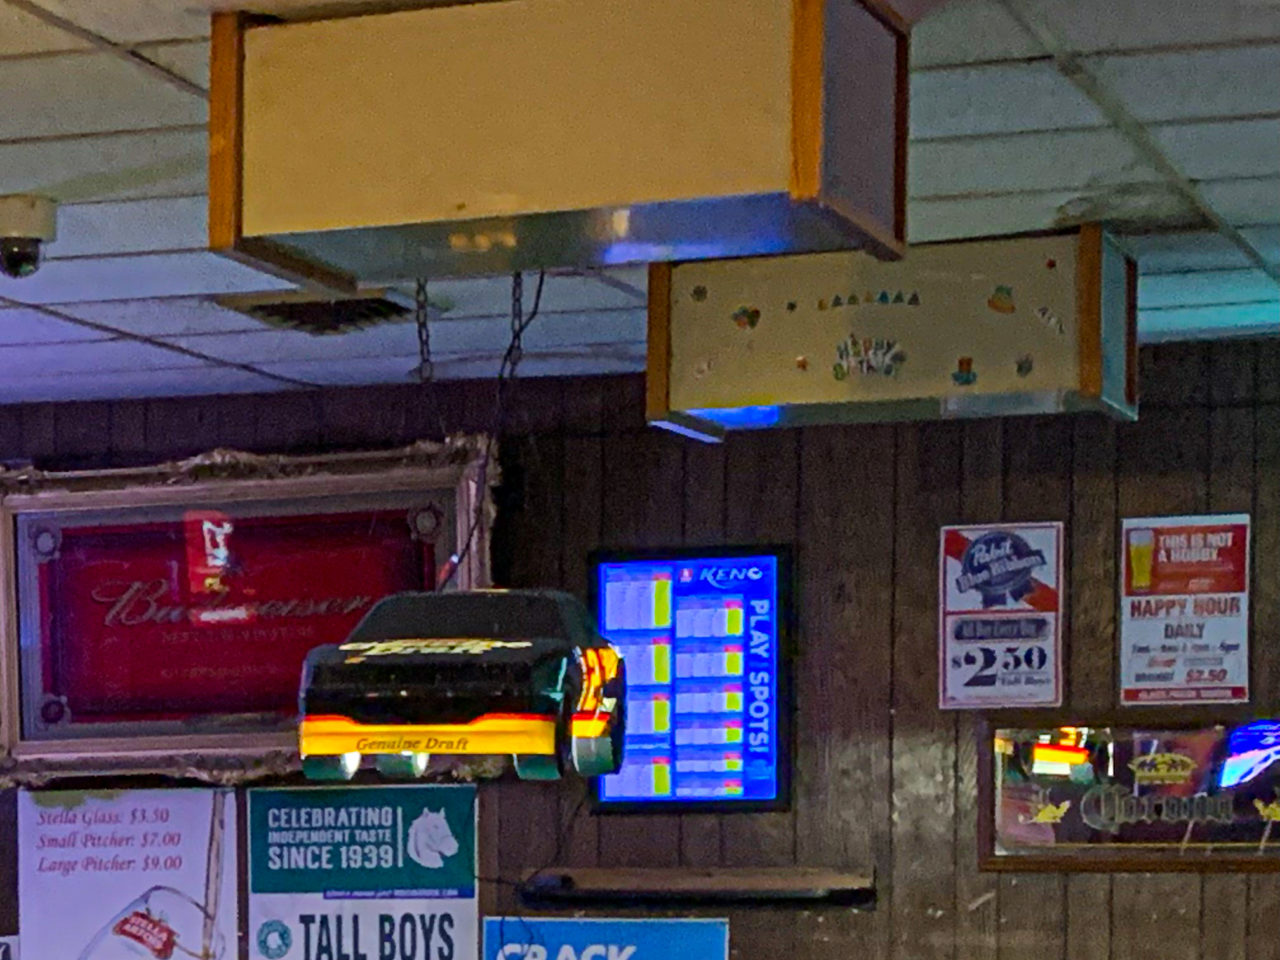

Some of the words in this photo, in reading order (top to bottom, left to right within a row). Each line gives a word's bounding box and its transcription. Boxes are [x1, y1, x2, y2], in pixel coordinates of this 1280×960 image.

[699, 567, 763, 586] KENO
[91, 577, 373, 628] Bueiser
[1130, 598, 1187, 618] HAPPY
[1193, 596, 1241, 615] HOUR
[749, 600, 770, 658] PLAY
[1164, 622, 1206, 640] DAILY
[356, 737, 421, 752] Genuine
[426, 736, 468, 751] Draft
[36, 809, 78, 826] Stella
[130, 807, 171, 826] $3.50
[268, 806, 393, 828] CELEBRATING
[36, 833, 77, 850] Small
[80, 832, 136, 850] Pitcher:
[140, 831, 182, 848] $7.00
[268, 830, 351, 844] INDEPENDENT
[354, 829, 393, 843] TASTE
[36, 856, 79, 877] Large
[81, 856, 137, 873] Pitcher:
[141, 855, 183, 872] $9.00
[268, 846, 334, 870] SINCE
[339, 845, 394, 869] 1939
